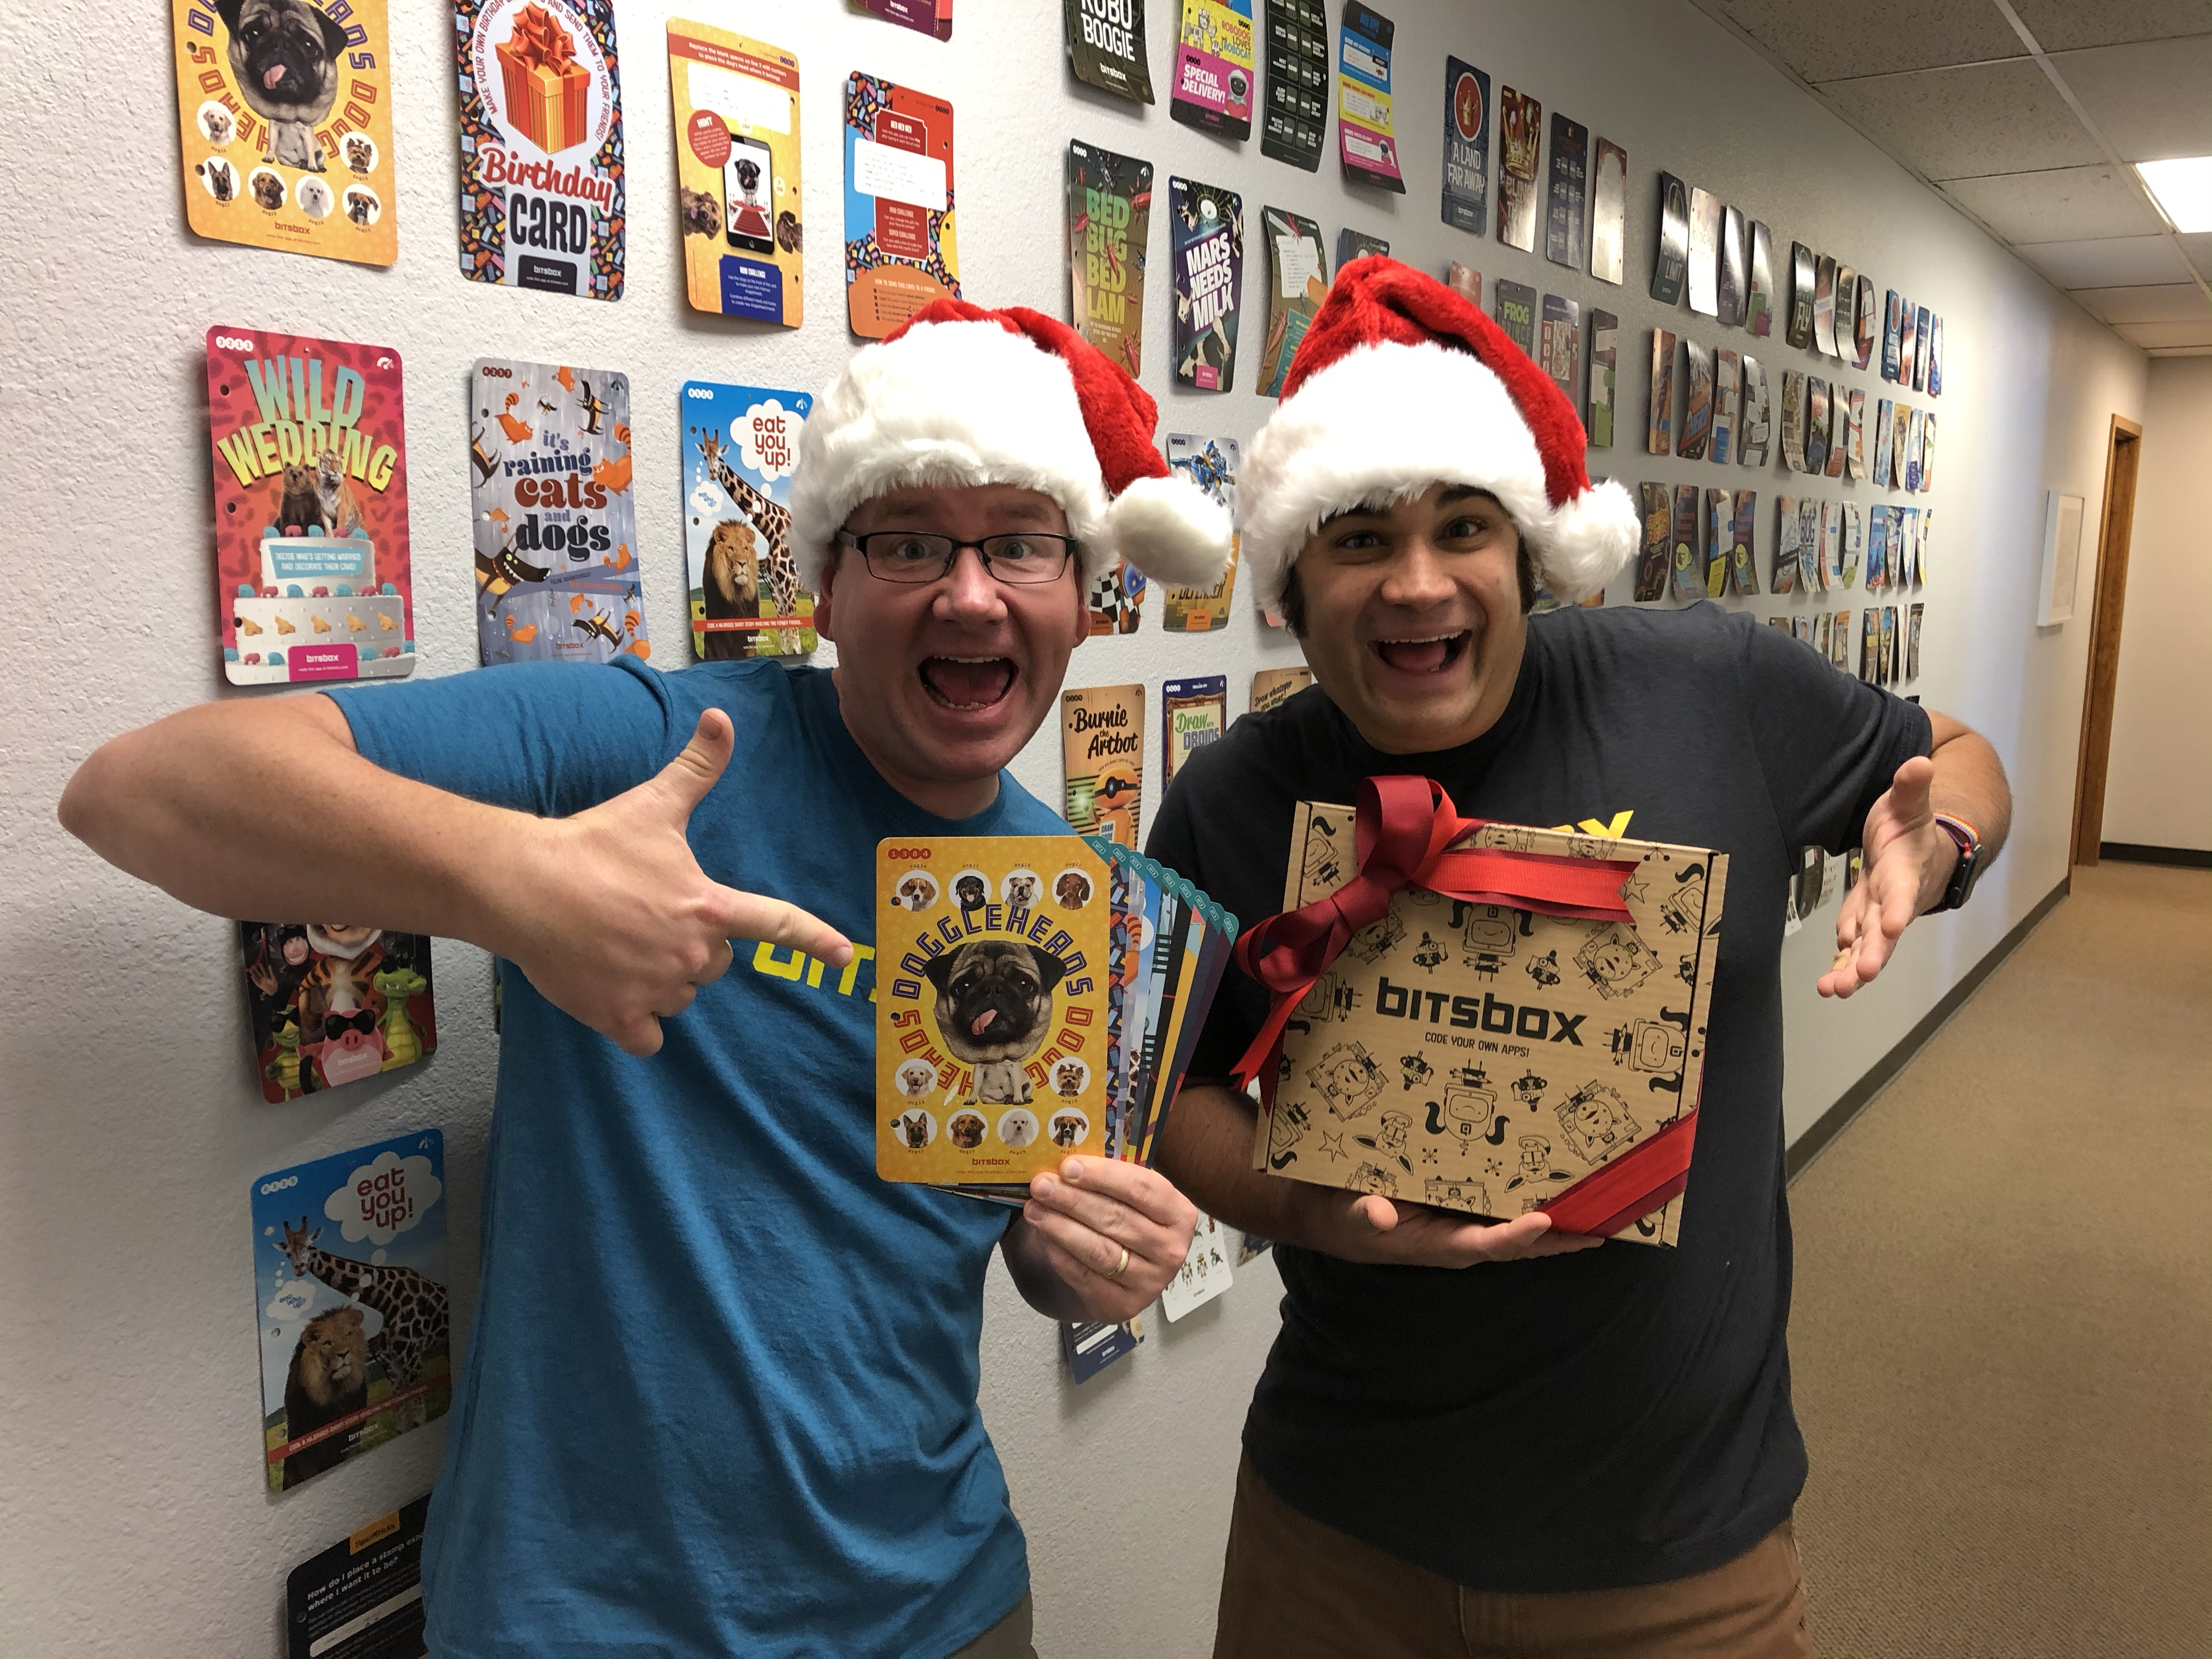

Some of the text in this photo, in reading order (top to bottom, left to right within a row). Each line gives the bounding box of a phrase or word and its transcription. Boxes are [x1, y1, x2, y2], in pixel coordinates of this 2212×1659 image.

[565, 9, 583, 32] SEND
[1221, 20, 1251, 41] ROBODOG
[583, 31, 599, 58] THEM
[689, 42, 708, 52] Replace
[1080, 12, 1136, 62] BOOGIE
[1223, 42, 1251, 60] ROBOCAT
[1233, 36, 1251, 52] LOVES
[475, 0, 505, 115] MAKE YOUR OWN BIRTHDAY
[595, 59, 605, 71] TO
[600, 75, 610, 100] YOUR
[1182, 78, 1226, 104] DELIVERY!
[1183, 64, 1219, 88] SPECIAL
[594, 102, 611, 142] FRIENDS!
[696, 116, 713, 129] HINT
[1453, 141, 1481, 171] A LAND
[482, 147, 613, 212] Birthday
[1447, 162, 1485, 194] FAR AWAY
[1086, 187, 1130, 229] BED
[1086, 222, 1127, 262] BUG
[1186, 232, 1231, 276] MARS
[1087, 253, 1126, 293] BED
[1189, 258, 1233, 301] NEEDS
[1087, 286, 1125, 324] LAM
[1193, 281, 1234, 332] MILK
[1504, 300, 1530, 325] FROG
[244, 354, 365, 428] WILD
[753, 416, 786, 434] eat
[543, 430, 569, 451] it's
[755, 434, 786, 455] you
[216, 419, 398, 494] WEDDING
[503, 447, 593, 477] raining
[765, 448, 791, 472] up!
[514, 472, 607, 510] cats
[544, 509, 571, 522] and
[515, 514, 611, 562] dogs
[314, 552, 336, 561] GETTING
[1254, 680, 1293, 707] Draw whatever
[1073, 703, 1128, 733] Burnie
[1175, 712, 1209, 733] Draw
[1087, 731, 1139, 759] Artbot
[1099, 729, 1110, 738] the
[889, 849, 930, 859] 1384
[892, 904, 1094, 1000] DOGGLEHEADS
[1425, 1031, 1530, 1058] CODE YOUR OWN APPS!
[357, 1167, 405, 1197] eat
[360, 1187, 405, 1221] you
[375, 1197, 414, 1231] up!
[307, 1585, 326, 1601] How
[329, 1578, 340, 1589] do
[347, 1561, 370, 1579] place
[379, 1543, 405, 1561] stamp
[308, 1592, 334, 1611] where
[341, 1576, 362, 1592] want
[364, 1571, 370, 1580] it
[372, 1567, 381, 1576] to
[383, 1556, 398, 1570] be?
